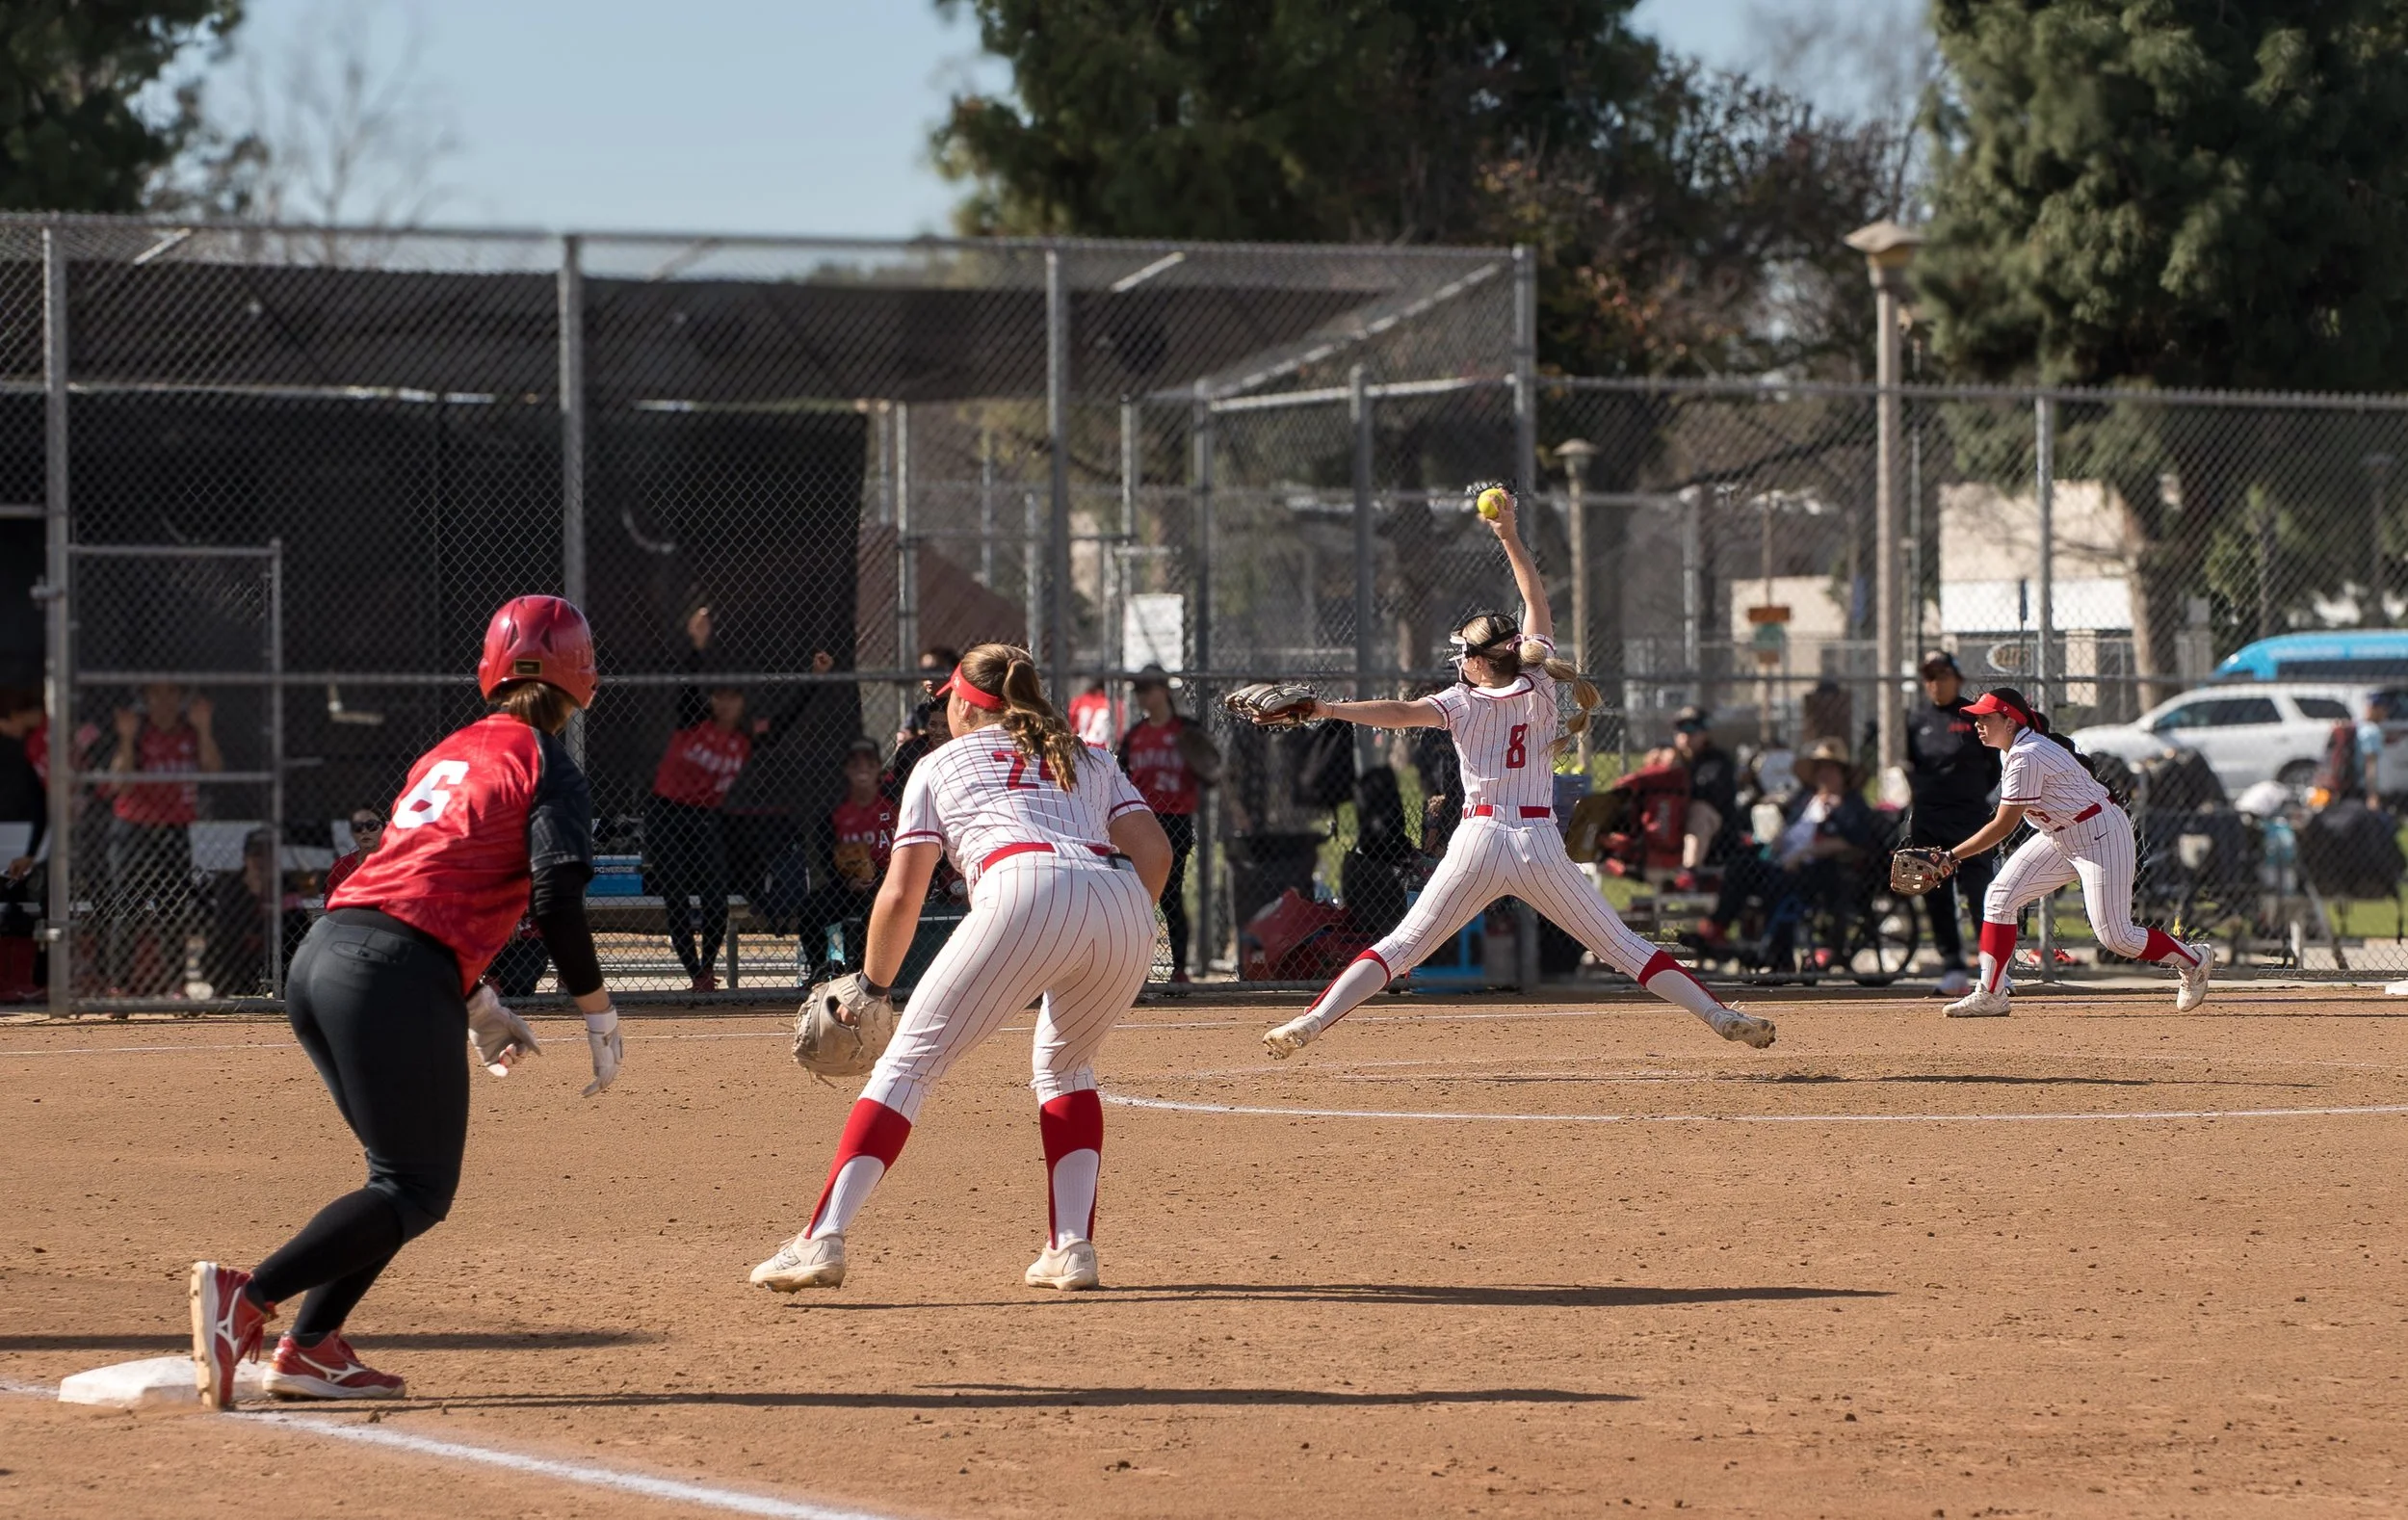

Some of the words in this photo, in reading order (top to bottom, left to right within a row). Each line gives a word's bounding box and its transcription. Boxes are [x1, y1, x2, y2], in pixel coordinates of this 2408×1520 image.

[1505, 722, 1528, 769] 8
[392, 759, 469, 829] 6
[842, 827, 896, 849] JAPA
